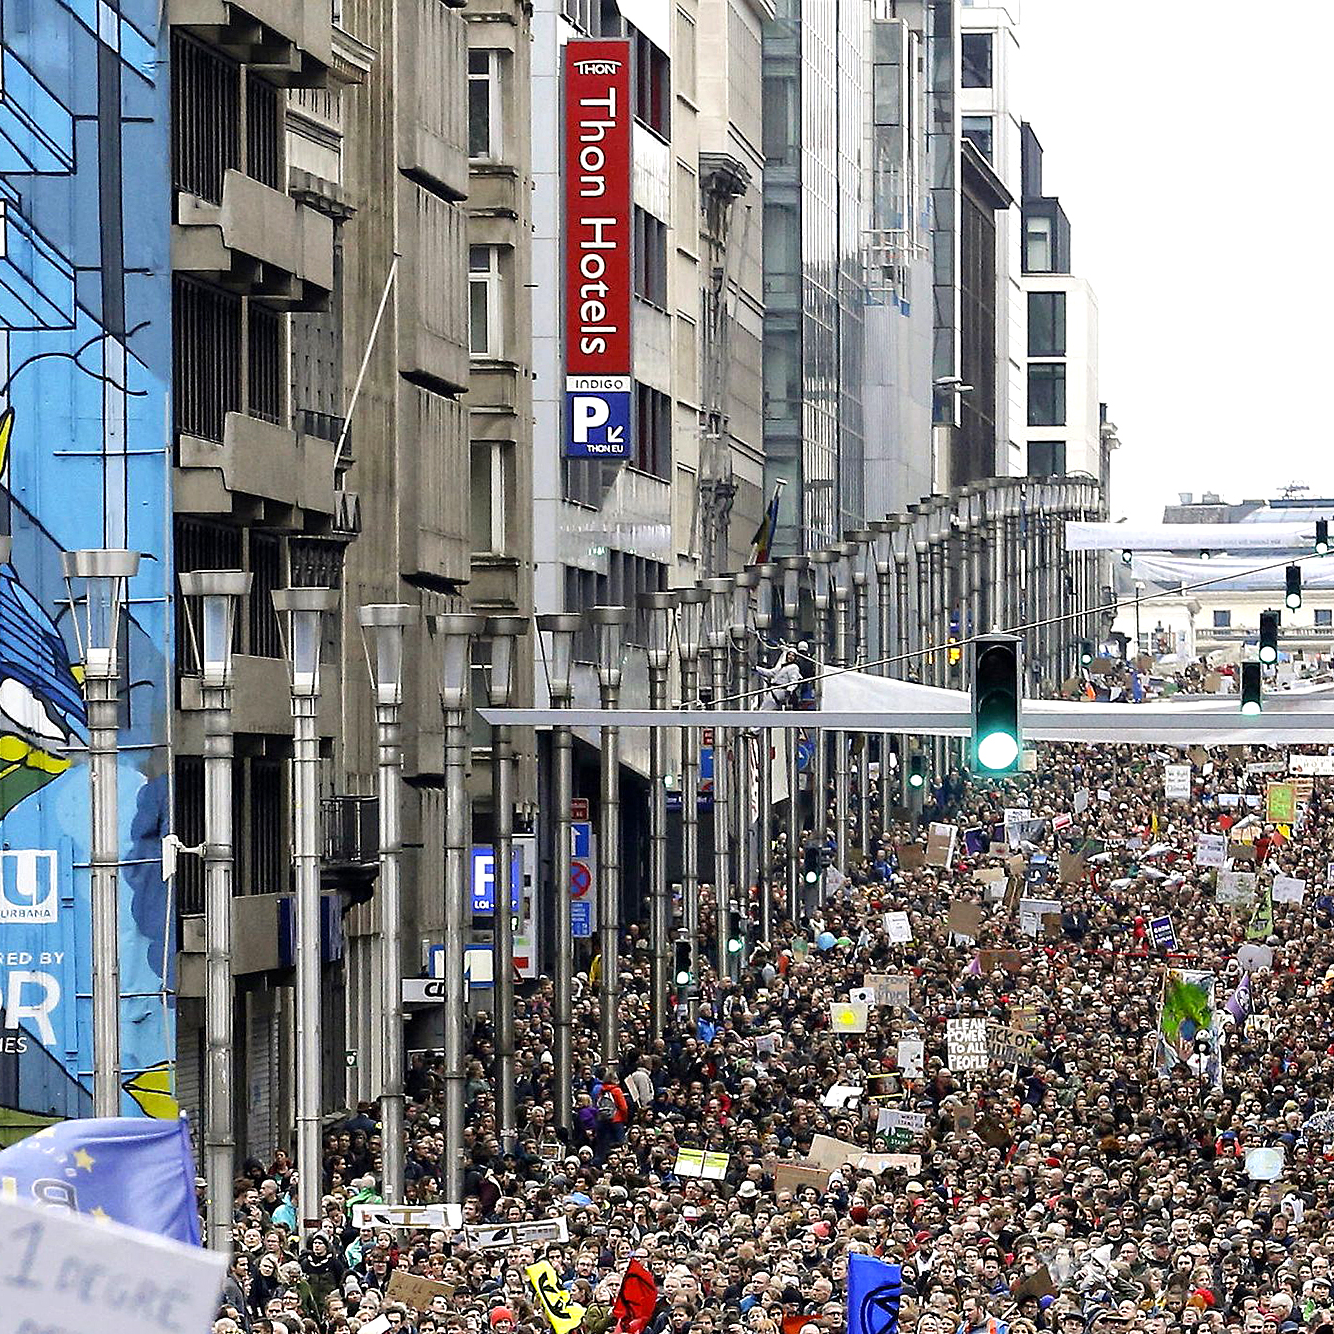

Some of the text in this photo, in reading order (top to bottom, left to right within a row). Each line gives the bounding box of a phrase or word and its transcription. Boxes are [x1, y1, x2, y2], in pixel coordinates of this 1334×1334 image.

[573, 59, 622, 75] THON
[579, 87, 618, 355] Thon Hotels
[575, 379, 624, 390] INDIGO
[573, 396, 610, 444] P
[587, 444, 624, 453] THON EU
[0, 909, 52, 919] URBANA
[40, 952, 65, 966] BY
[947, 1018, 986, 1030] CLEAN
[947, 1030, 987, 1042] POWER
[948, 1042, 988, 1054] TO ALL
[948, 1054, 989, 1071] PEOPLE
